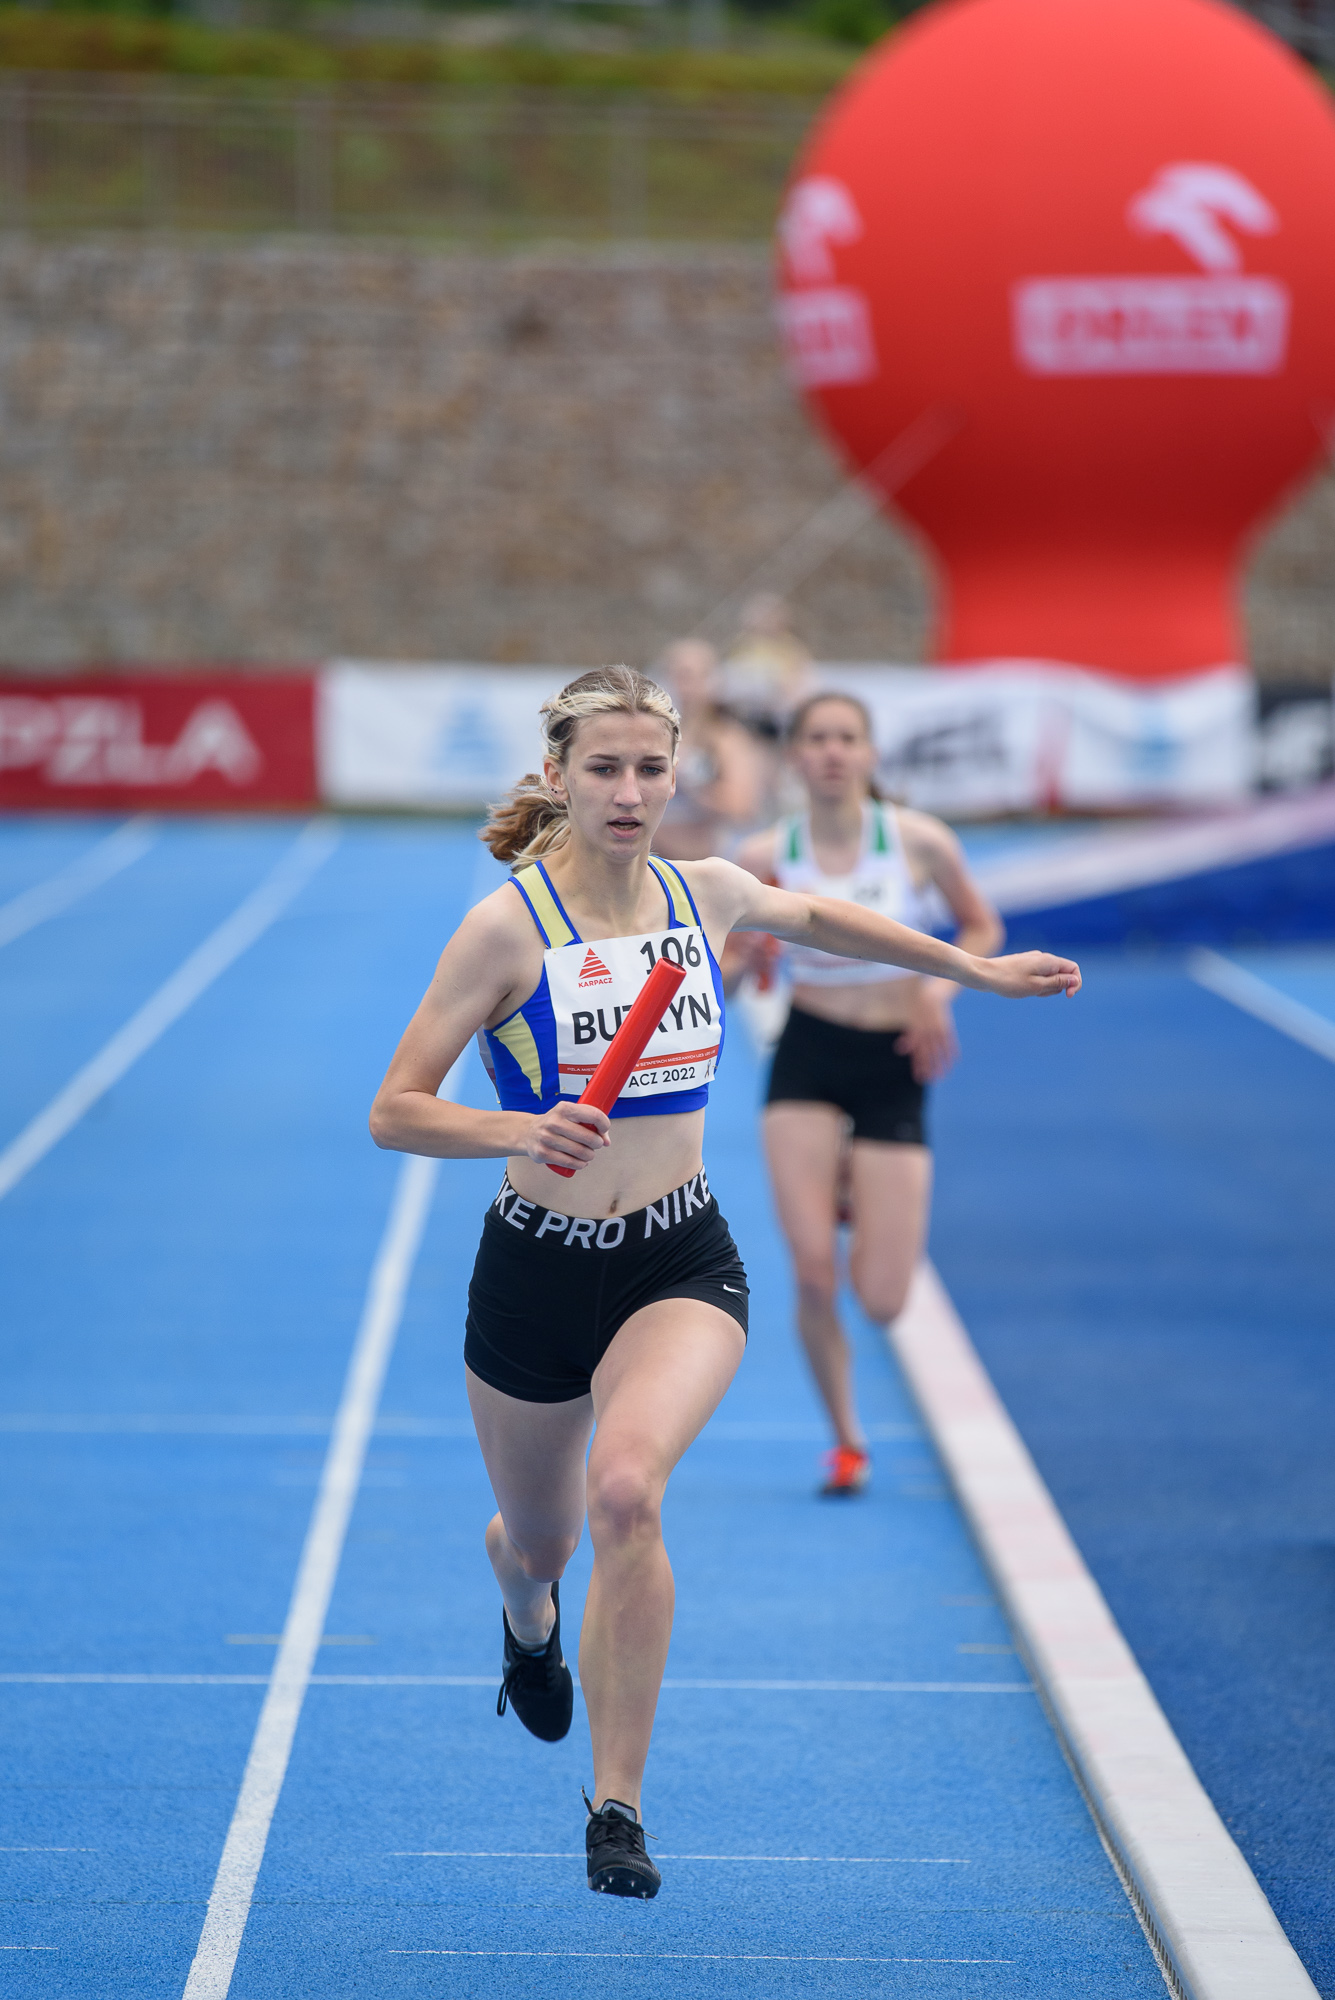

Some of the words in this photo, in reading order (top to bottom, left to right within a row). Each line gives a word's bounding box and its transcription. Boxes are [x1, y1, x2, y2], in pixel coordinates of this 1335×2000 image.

[640, 934, 702, 975] 106
[578, 977, 613, 988] KARPACZ
[572, 992, 712, 1045] BUYN
[662, 1066, 696, 1083] 2022
[535, 1210, 627, 1250] PRO
[644, 1164, 711, 1239] NIKE
